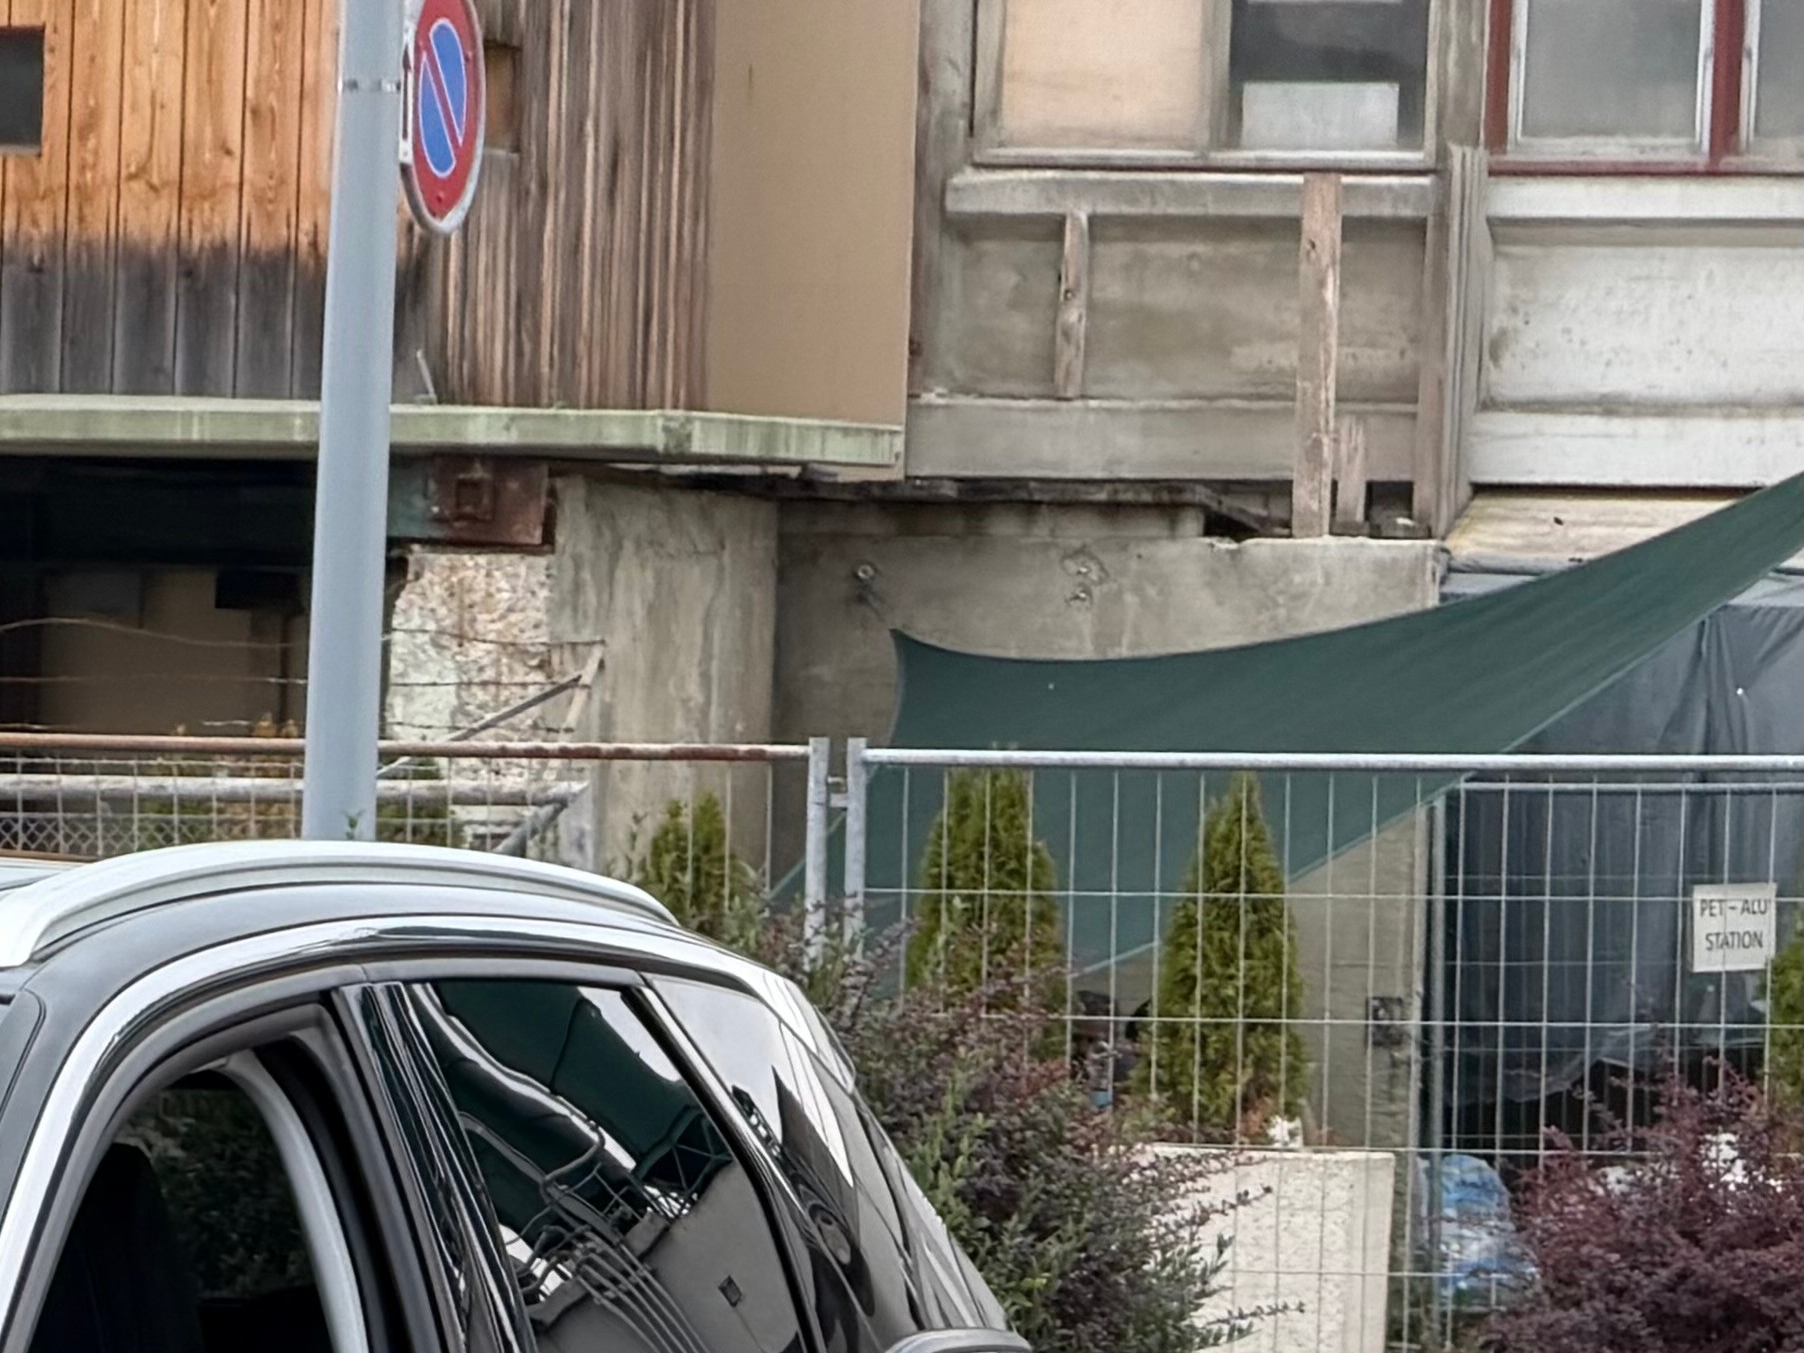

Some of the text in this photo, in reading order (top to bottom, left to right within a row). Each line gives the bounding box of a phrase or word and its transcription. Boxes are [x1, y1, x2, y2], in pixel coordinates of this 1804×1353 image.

[1700, 899, 1725, 917] PET
[1741, 899, 1768, 915] ALU
[1705, 931, 1764, 951] STATION
